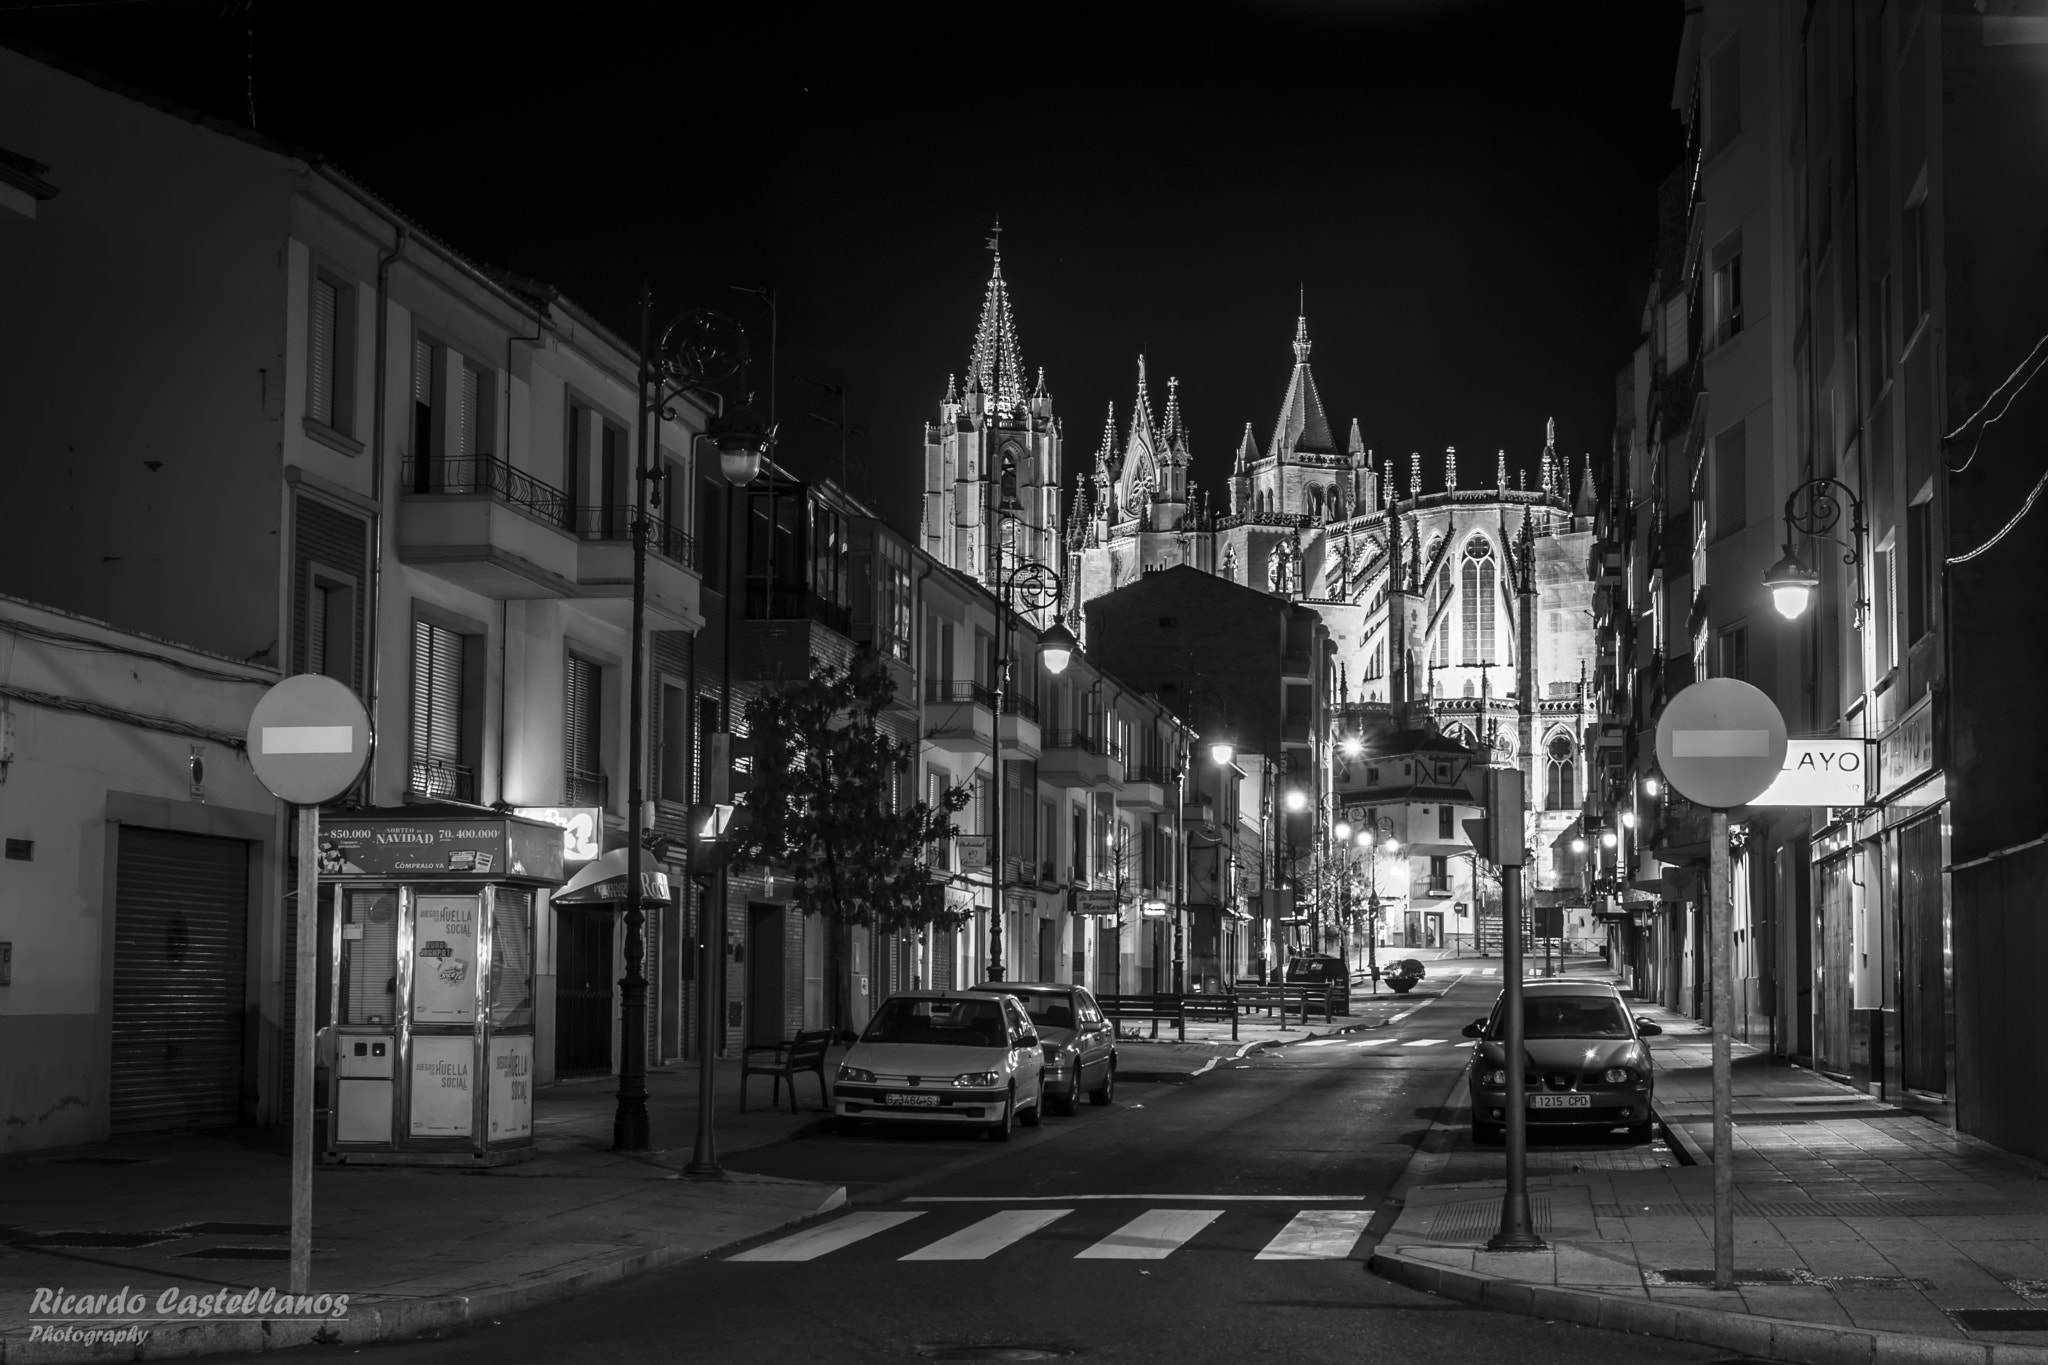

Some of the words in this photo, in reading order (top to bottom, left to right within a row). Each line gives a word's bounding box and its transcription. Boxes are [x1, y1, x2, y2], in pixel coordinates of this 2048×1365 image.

[1782, 752, 1860, 772] AYO
[330, 829, 371, 839] 850.000
[376, 834, 434, 844] NAVIDAD
[438, 829, 452, 839] 70
[420, 910, 439, 918] JUEGOS
[440, 907, 472, 922] HUELLA
[446, 924, 472, 937] SOCIAL
[415, 1063, 435, 1071] JUEGOS
[436, 1060, 468, 1076] HUELLA
[508, 1048, 528, 1077] HUELLA
[442, 1077, 468, 1090] SOCIAL
[512, 1080, 527, 1104] SOCIAL
[1539, 1097, 1563, 1107] 1215
[1568, 1096, 1587, 1106] CPD
